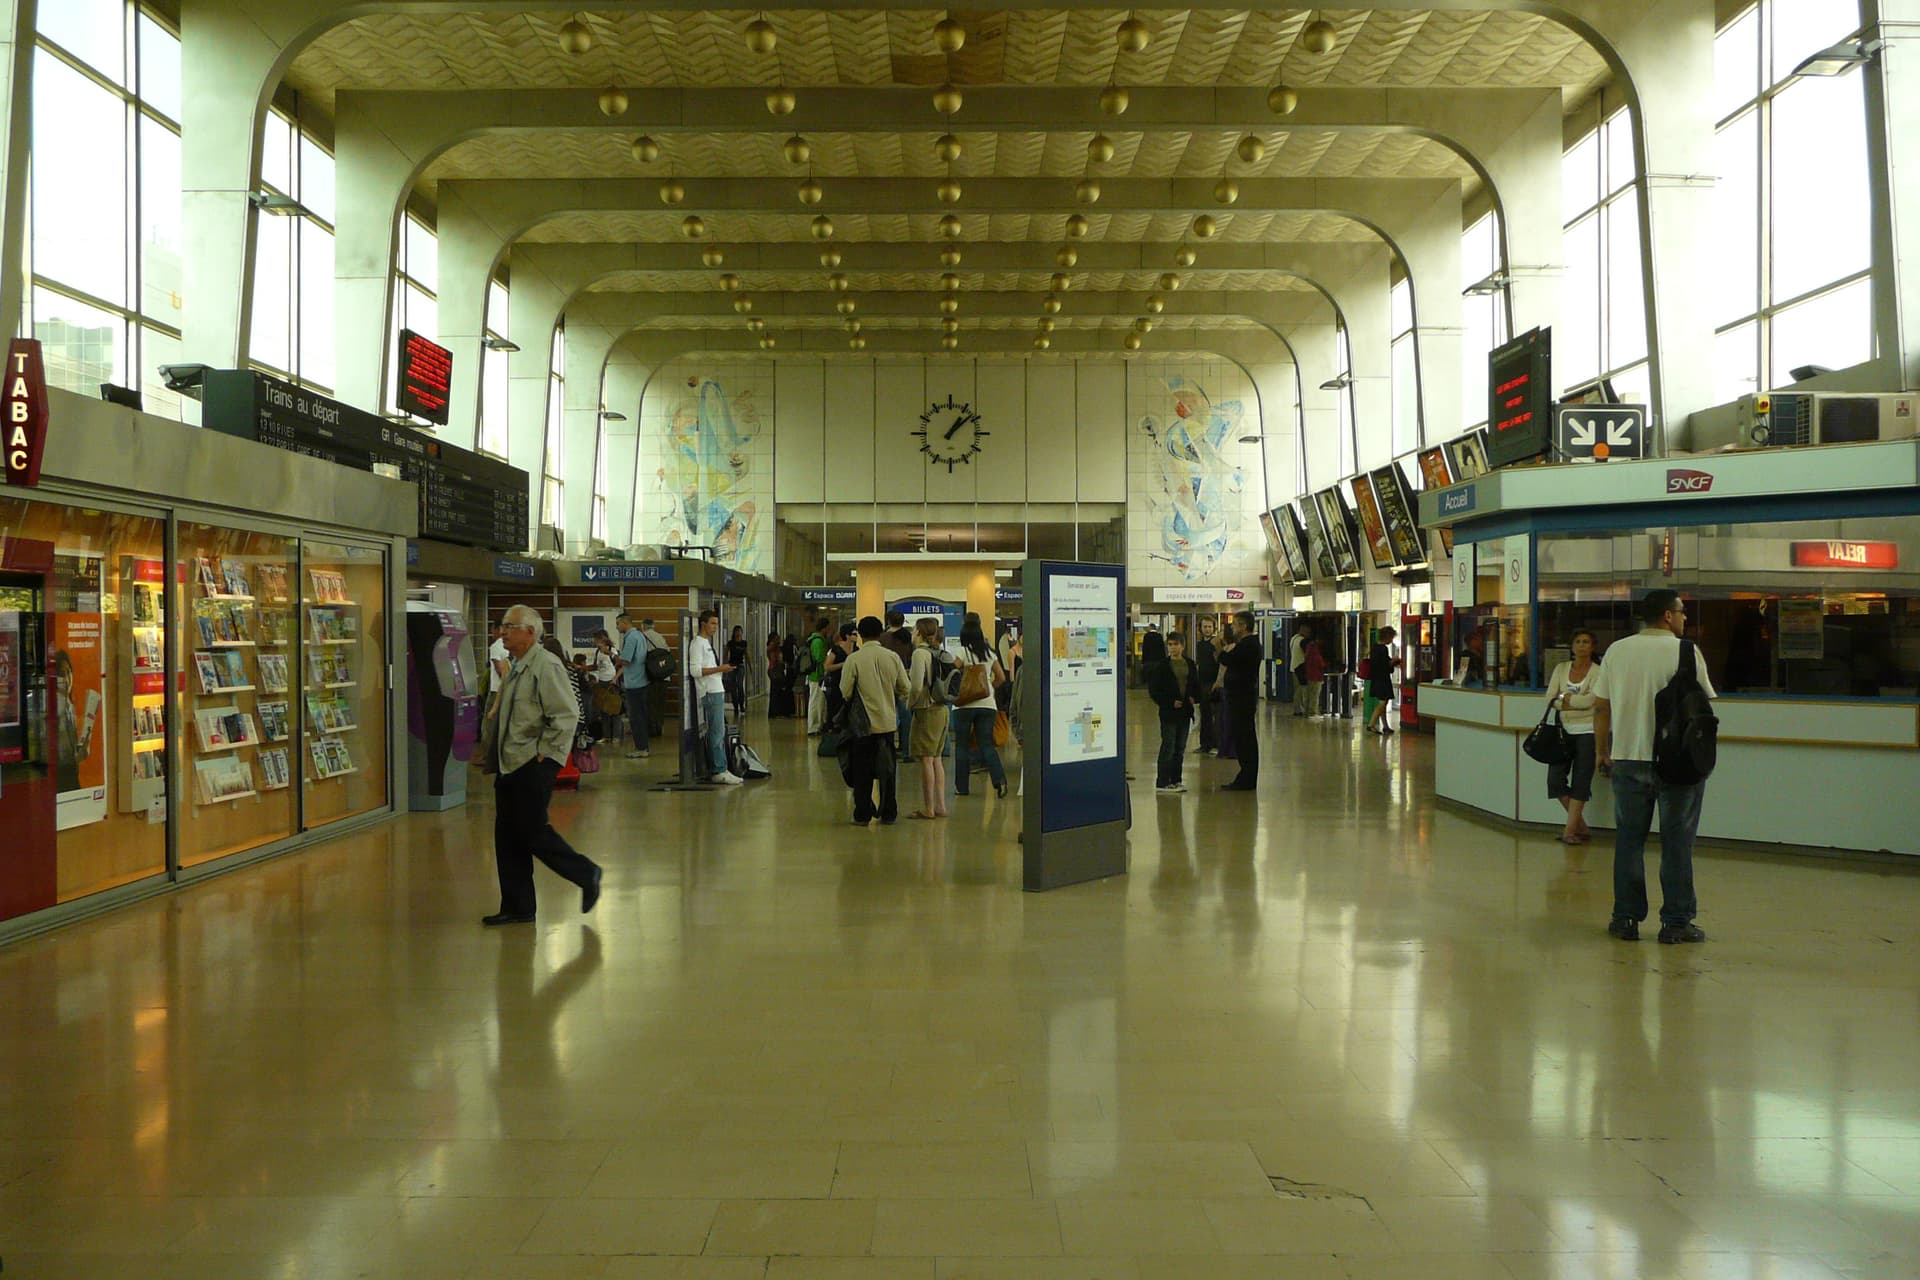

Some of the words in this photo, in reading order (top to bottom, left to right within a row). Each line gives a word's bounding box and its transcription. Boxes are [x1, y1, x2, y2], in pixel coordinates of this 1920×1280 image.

[11, 353, 29, 470] TABAC
[263, 380, 293, 409] Trains
[297, 397, 309, 415] au
[312, 400, 340, 425] départ
[1668, 476, 1711, 491] SNCF
[1445, 489, 1468, 511] Accueil
[912, 605, 940, 613] BILLETS
